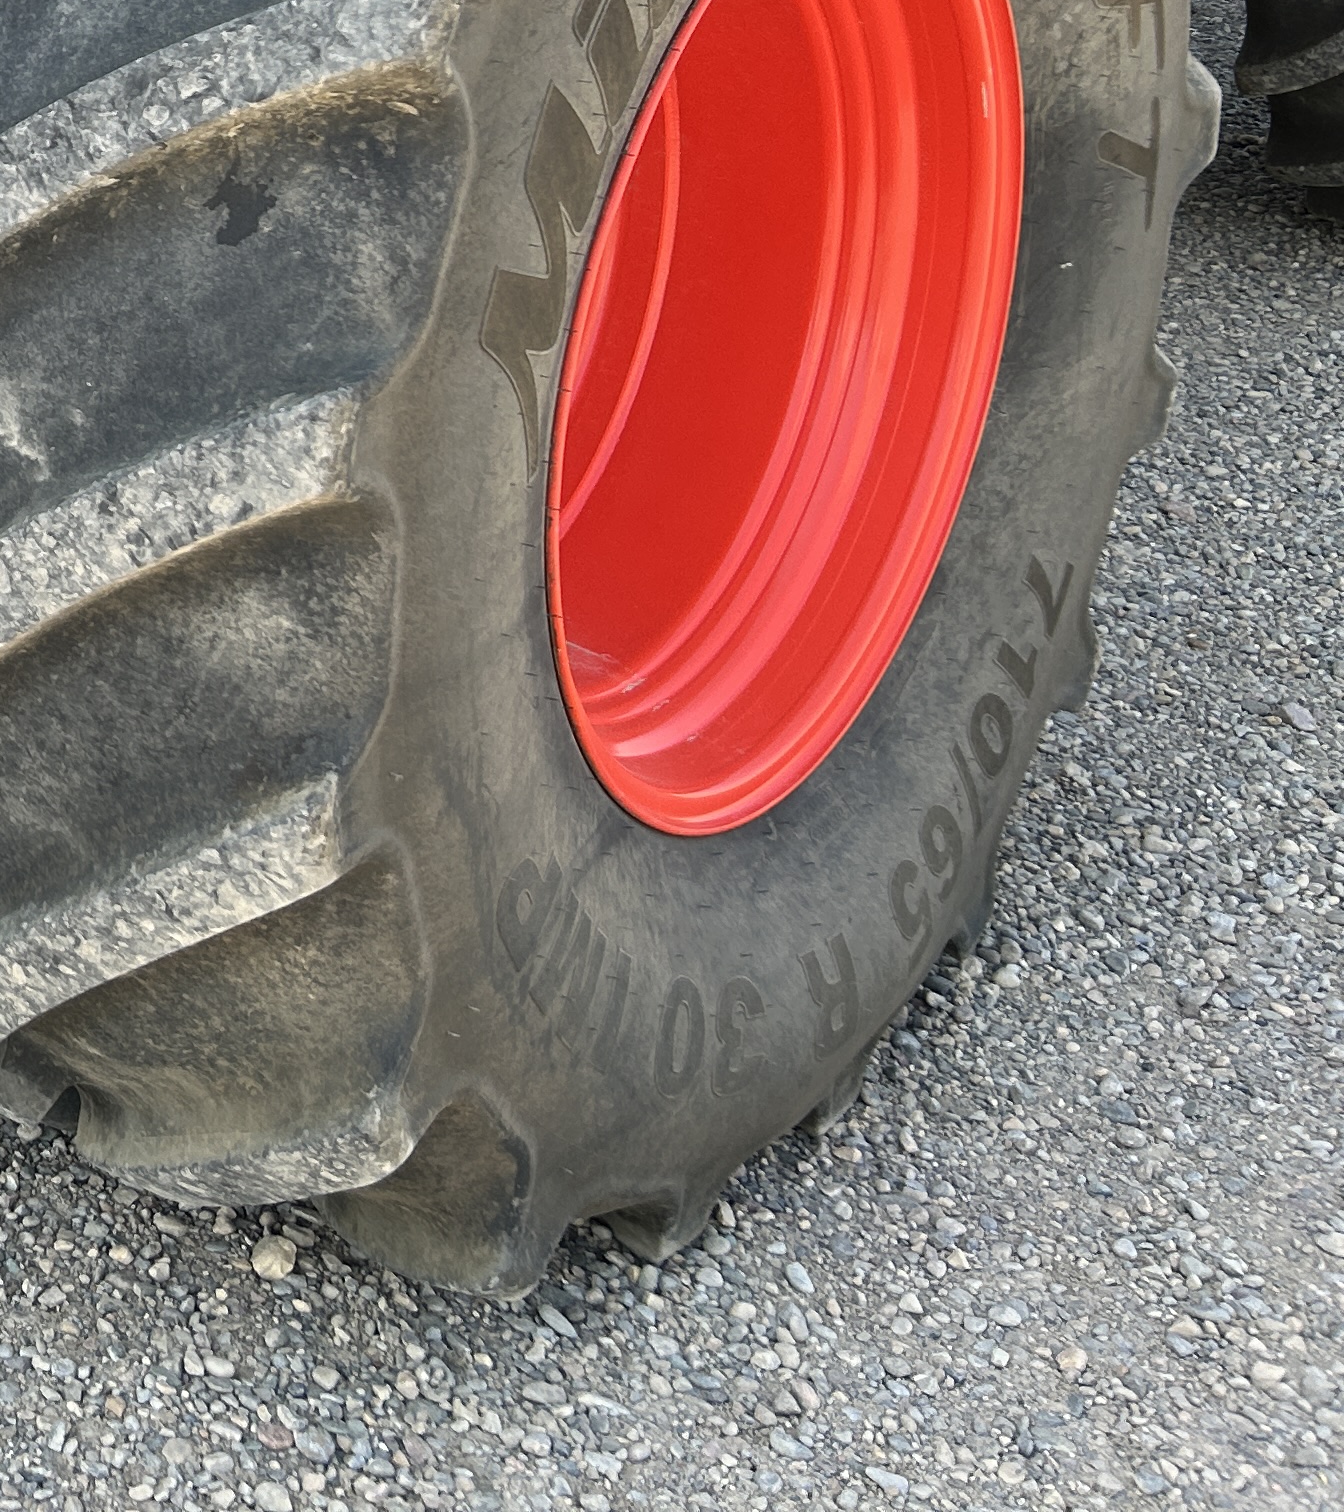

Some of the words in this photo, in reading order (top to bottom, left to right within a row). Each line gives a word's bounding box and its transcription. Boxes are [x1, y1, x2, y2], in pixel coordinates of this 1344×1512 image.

[888, 552, 1075, 976] 710/65
[653, 973, 767, 1099] 30
[798, 932, 861, 1062] R
